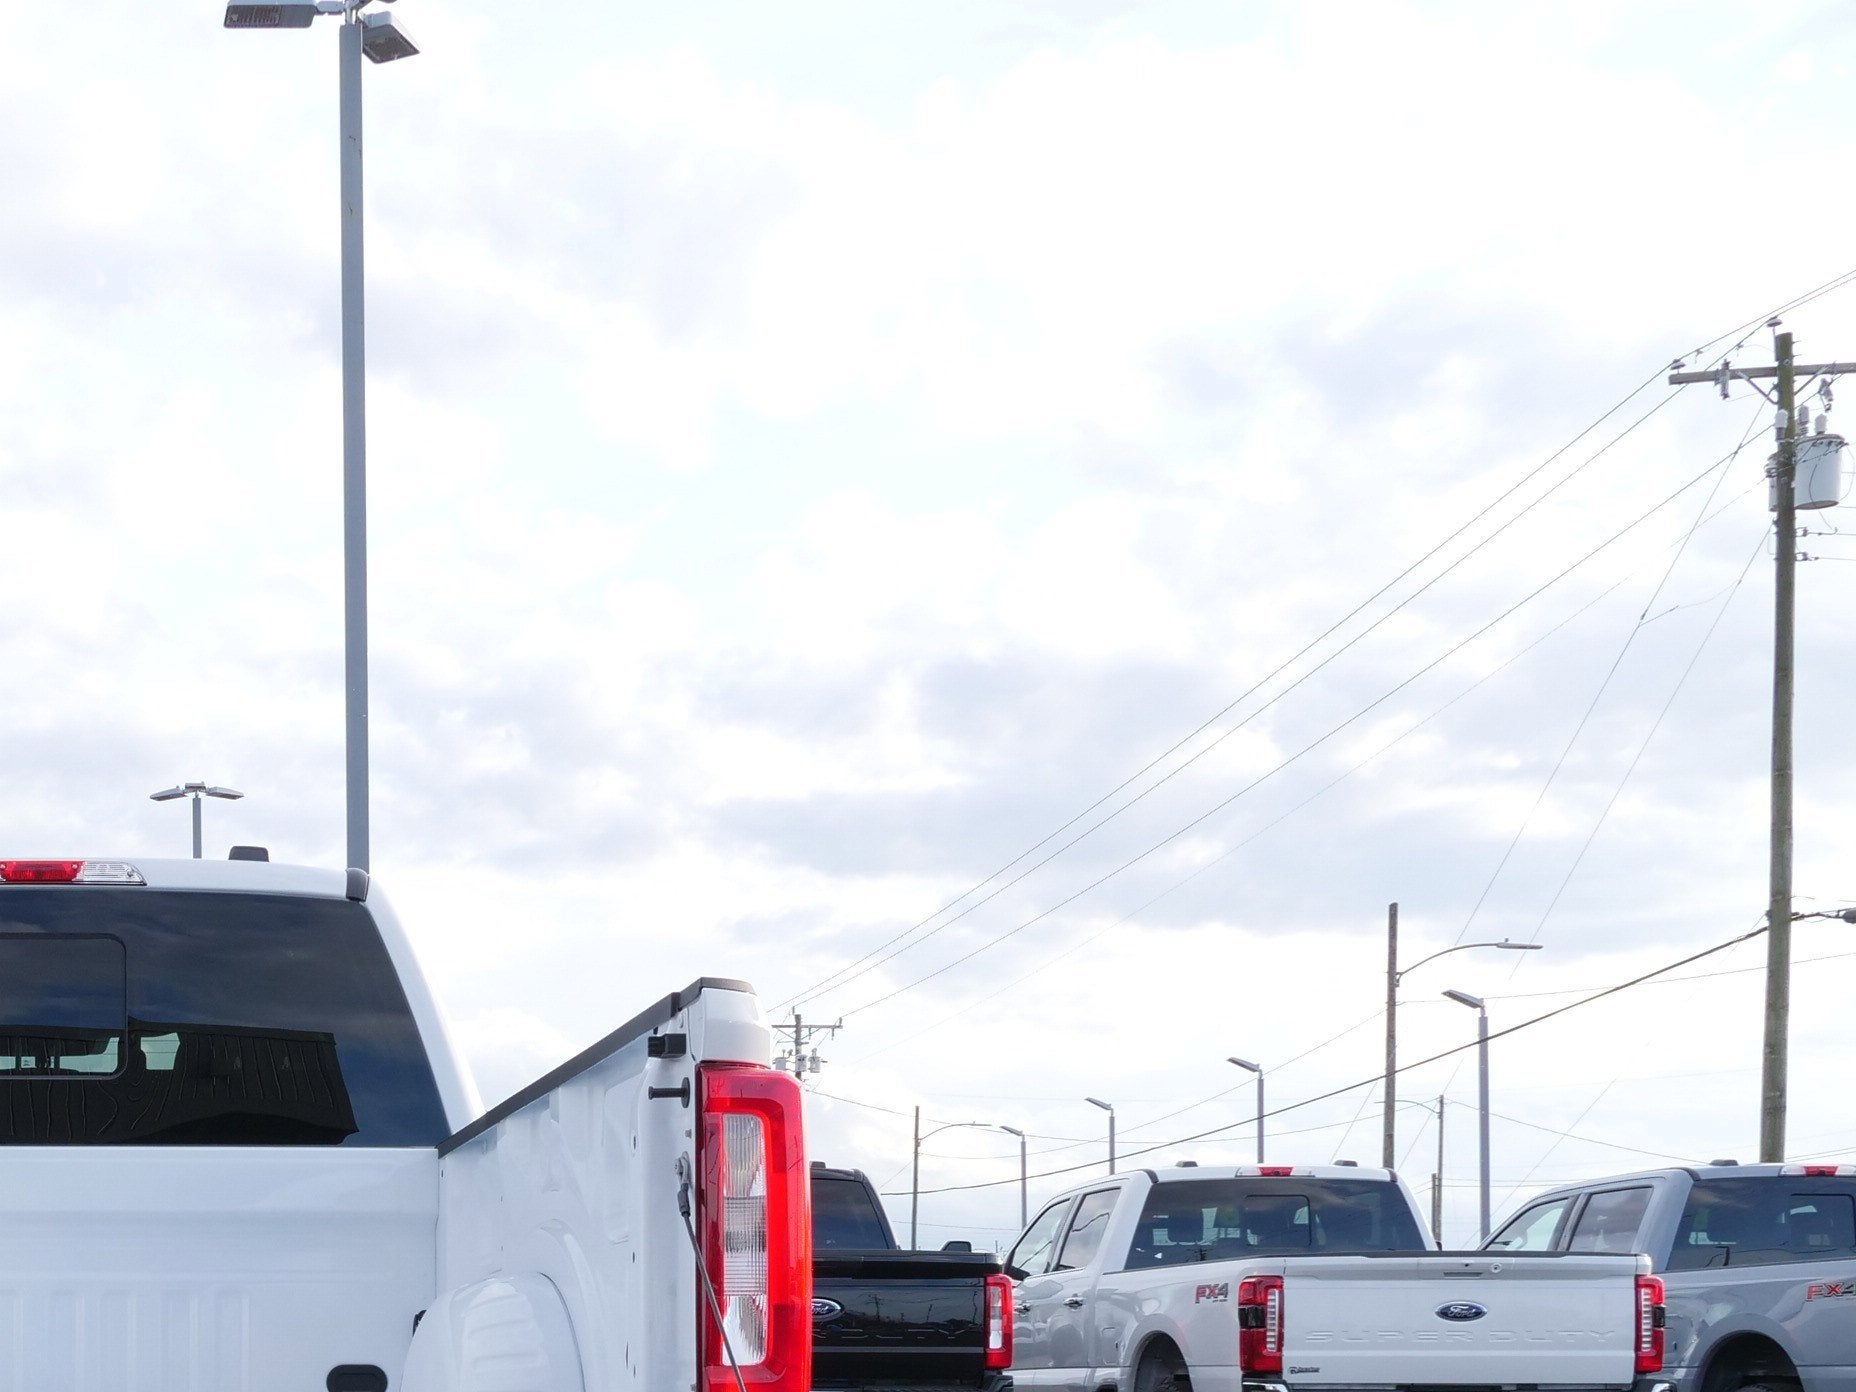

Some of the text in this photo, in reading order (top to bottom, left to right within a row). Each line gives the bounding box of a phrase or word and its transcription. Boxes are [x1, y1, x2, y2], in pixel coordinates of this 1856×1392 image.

[1195, 1283, 1228, 1304] FX4
[1305, 1330, 1616, 1342] SUPER DUTY
